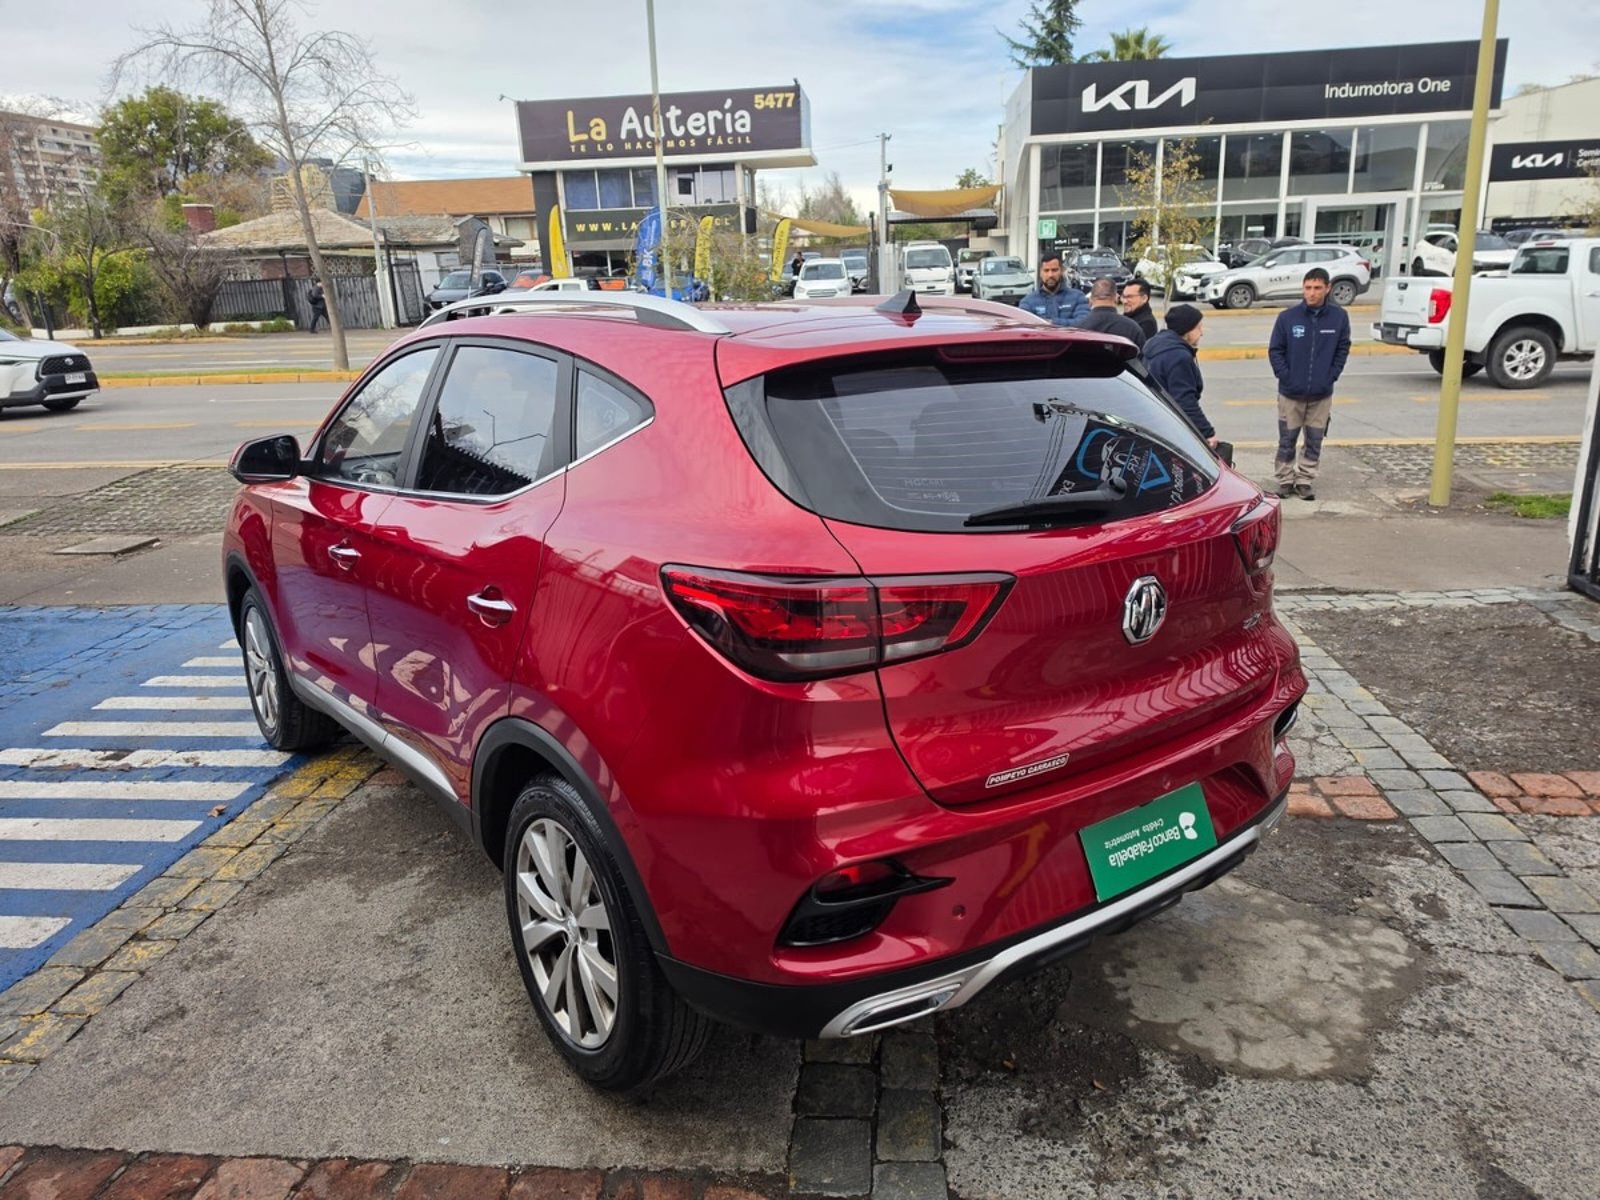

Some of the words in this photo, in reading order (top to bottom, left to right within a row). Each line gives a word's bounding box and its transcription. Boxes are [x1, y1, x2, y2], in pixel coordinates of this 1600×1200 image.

[1324, 81, 1415, 99] Indumotora
[1418, 78, 1451, 93] One
[753, 92, 796, 109] 5477
[566, 110, 608, 142] La
[620, 98, 752, 140] Autería
[570, 144, 587, 153] TE
[596, 143, 615, 152] LO
[624, 137, 697, 151] HACMOS
[1104, 829, 1141, 850] Automotriz
